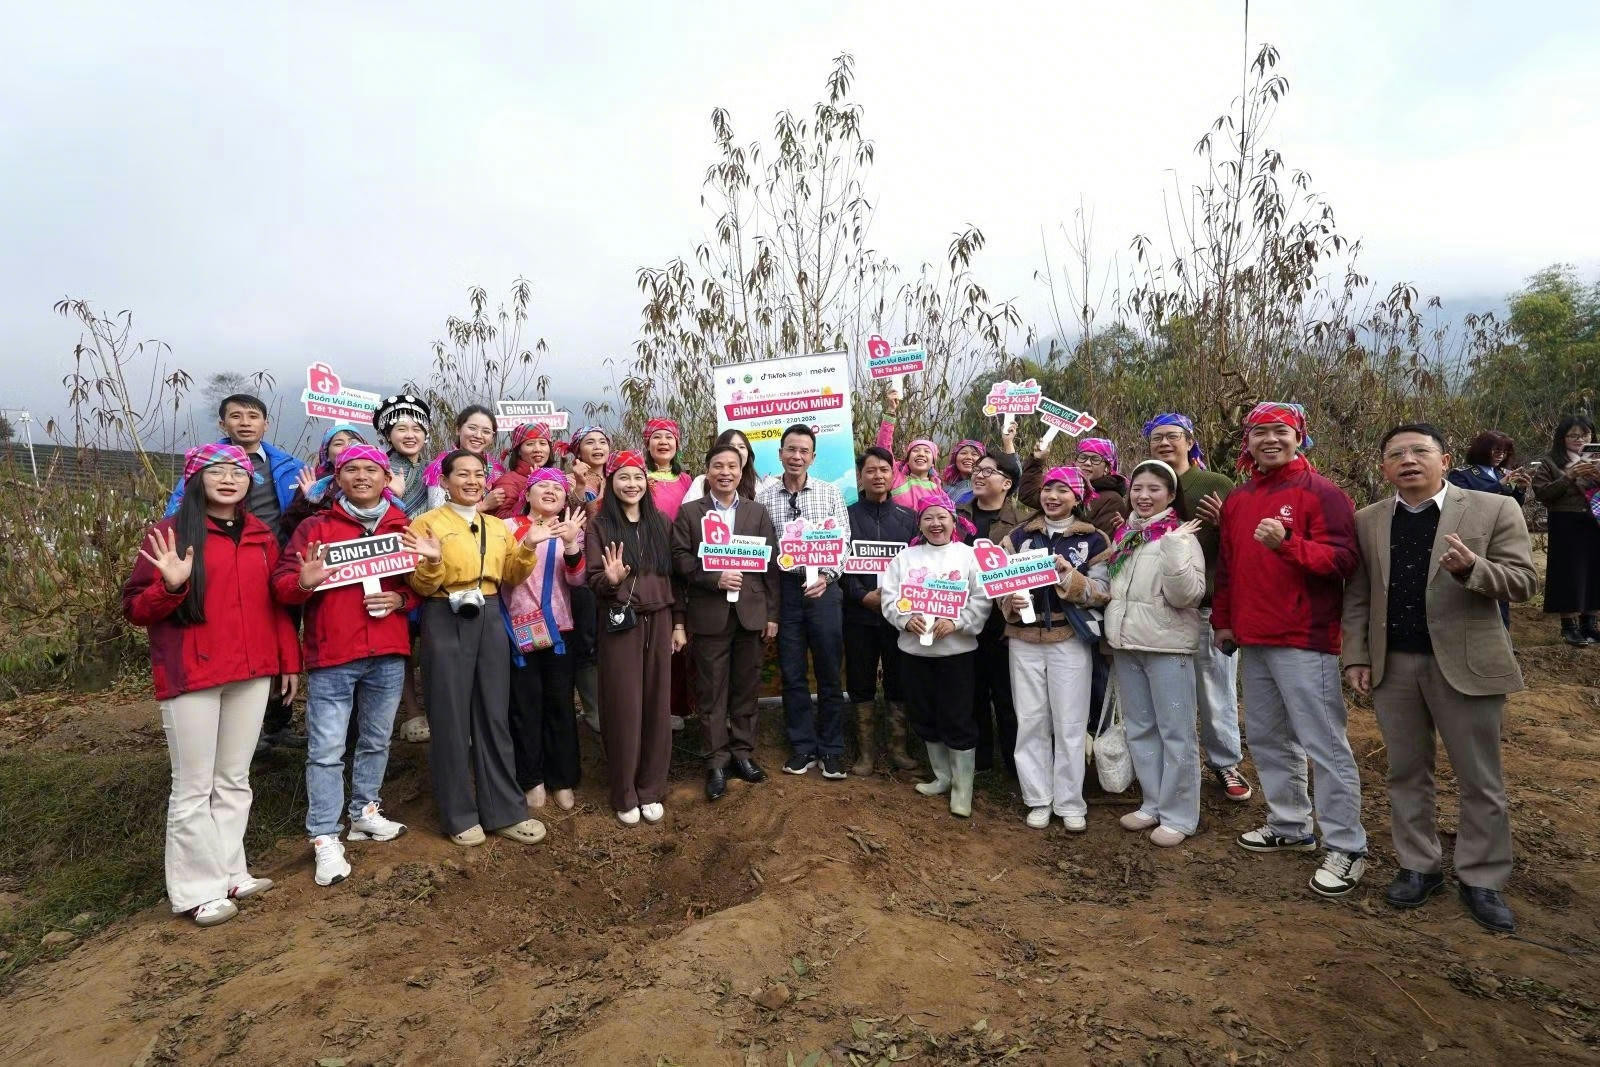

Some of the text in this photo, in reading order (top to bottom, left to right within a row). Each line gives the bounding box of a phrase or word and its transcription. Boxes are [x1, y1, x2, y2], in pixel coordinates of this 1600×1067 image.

[309, 393, 330, 402] Buôn
[1011, 395, 1035, 403] Xuân
[313, 404, 325, 412] Tết
[506, 404, 549, 414] BÌNH LƯ
[733, 396, 840, 416] BÌNH LƯ VƯƠN MÌNH
[1009, 403, 1030, 412] Nhà
[1042, 402, 1061, 414] HÀNG
[1062, 420, 1077, 433] MÌNH
[761, 428, 781, 438] 50%
[330, 537, 394, 563] BÌNH LƯ
[704, 546, 723, 554] Buôn
[738, 548, 751, 556] Bán
[752, 549, 765, 557] Đất
[811, 541, 839, 551] Xuân
[860, 544, 886, 556] BÌNH
[808, 552, 834, 564] Nhà
[371, 555, 414, 574] MÌNH
[848, 560, 881, 570] VƯƠN
[982, 572, 1003, 581] Buôn
[1005, 568, 1018, 577] Vui
[1020, 565, 1036, 574] Bán
[990, 583, 1003, 591] Tết
[1005, 581, 1014, 589] Ta
[1028, 574, 1049, 584] Miền
[904, 587, 961, 602] Chở Xuân
[927, 601, 954, 614] Nhà
